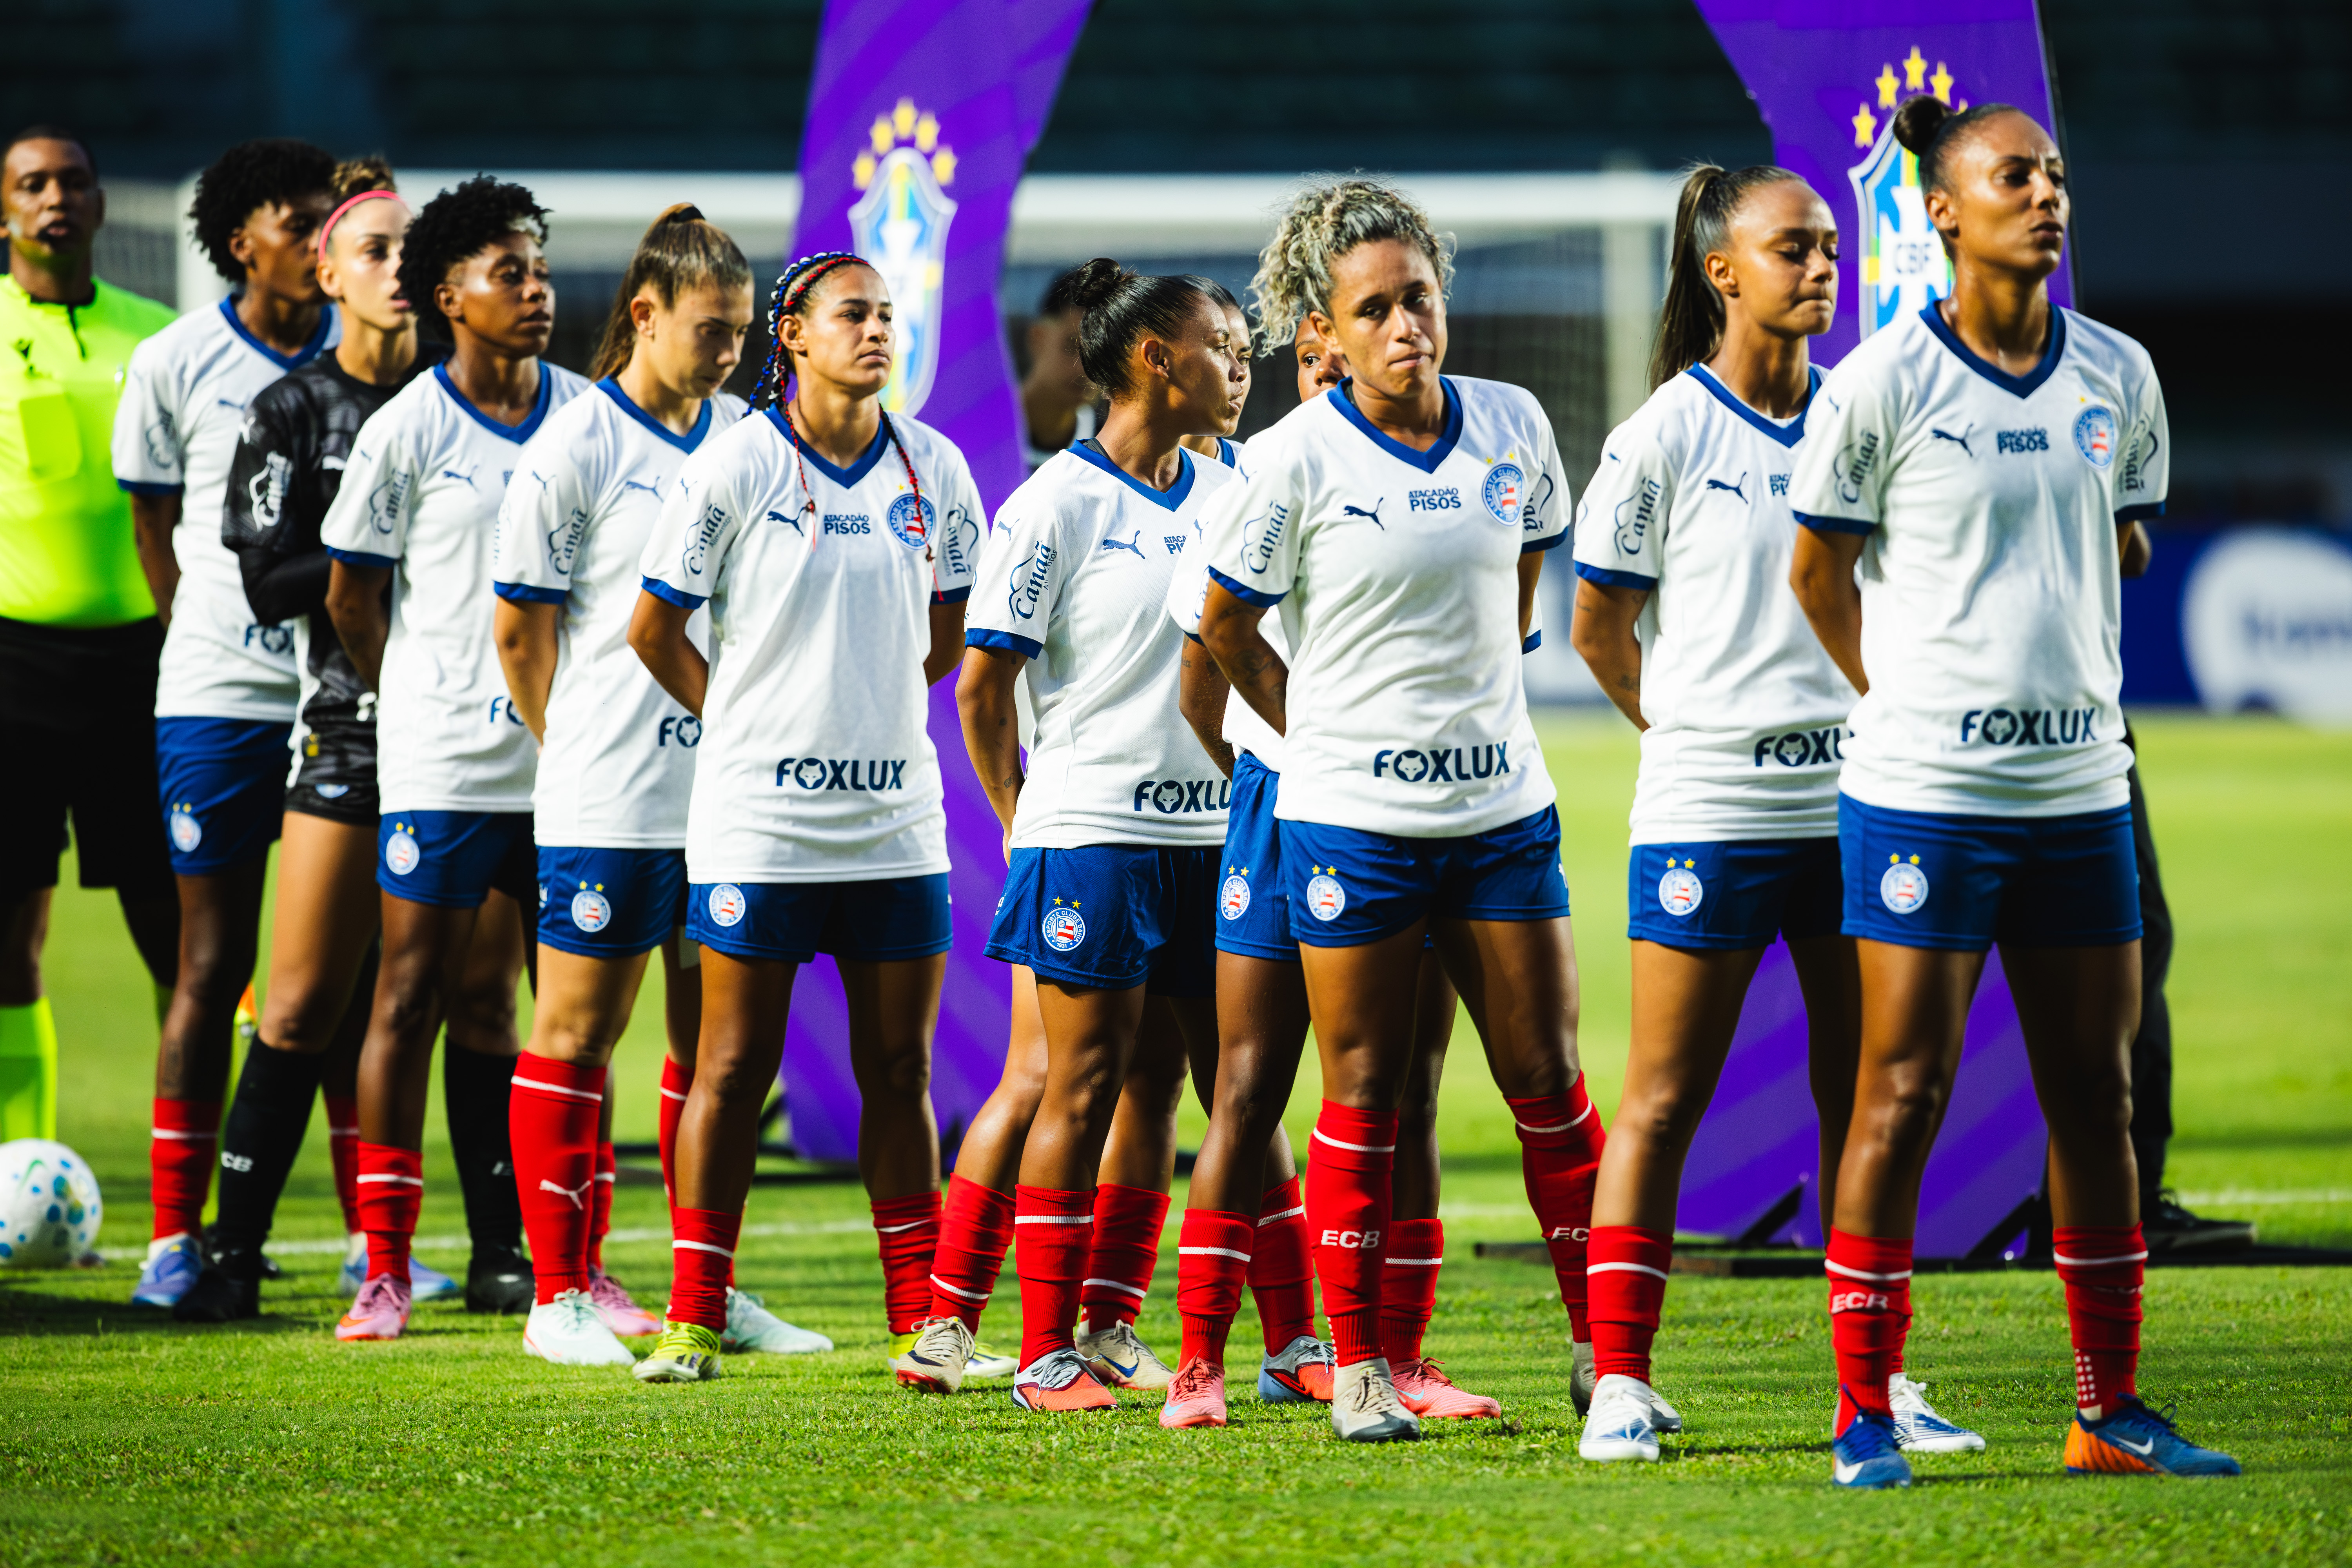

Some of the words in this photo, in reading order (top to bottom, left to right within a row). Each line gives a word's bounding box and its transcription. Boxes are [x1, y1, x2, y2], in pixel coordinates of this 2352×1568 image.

[1998, 437, 2049, 453] PISOS
[1409, 486, 1458, 498] ATACADÃO
[1410, 496, 1461, 511] PISOS
[824, 513, 869, 522] ATACADÃO
[825, 523, 870, 534] PISOS
[1622, 477, 1660, 555] Canaã
[947, 510, 971, 574] Canaã
[1164, 535, 1187, 543] ATACA
[1248, 500, 1288, 574] Canaã
[1016, 541, 1051, 619] Canaã
[1962, 707, 2096, 746] FOXLUX
[1374, 741, 1510, 782] FOXLUX
[1755, 728, 1855, 767] FOXL
[777, 758, 906, 790] FOXLUX
[1046, 911, 1060, 937] ESPORTE
[1061, 911, 1080, 923] CLUBE
[1074, 924, 1083, 942] BAHIA
[1321, 1229, 1380, 1248] ECB
